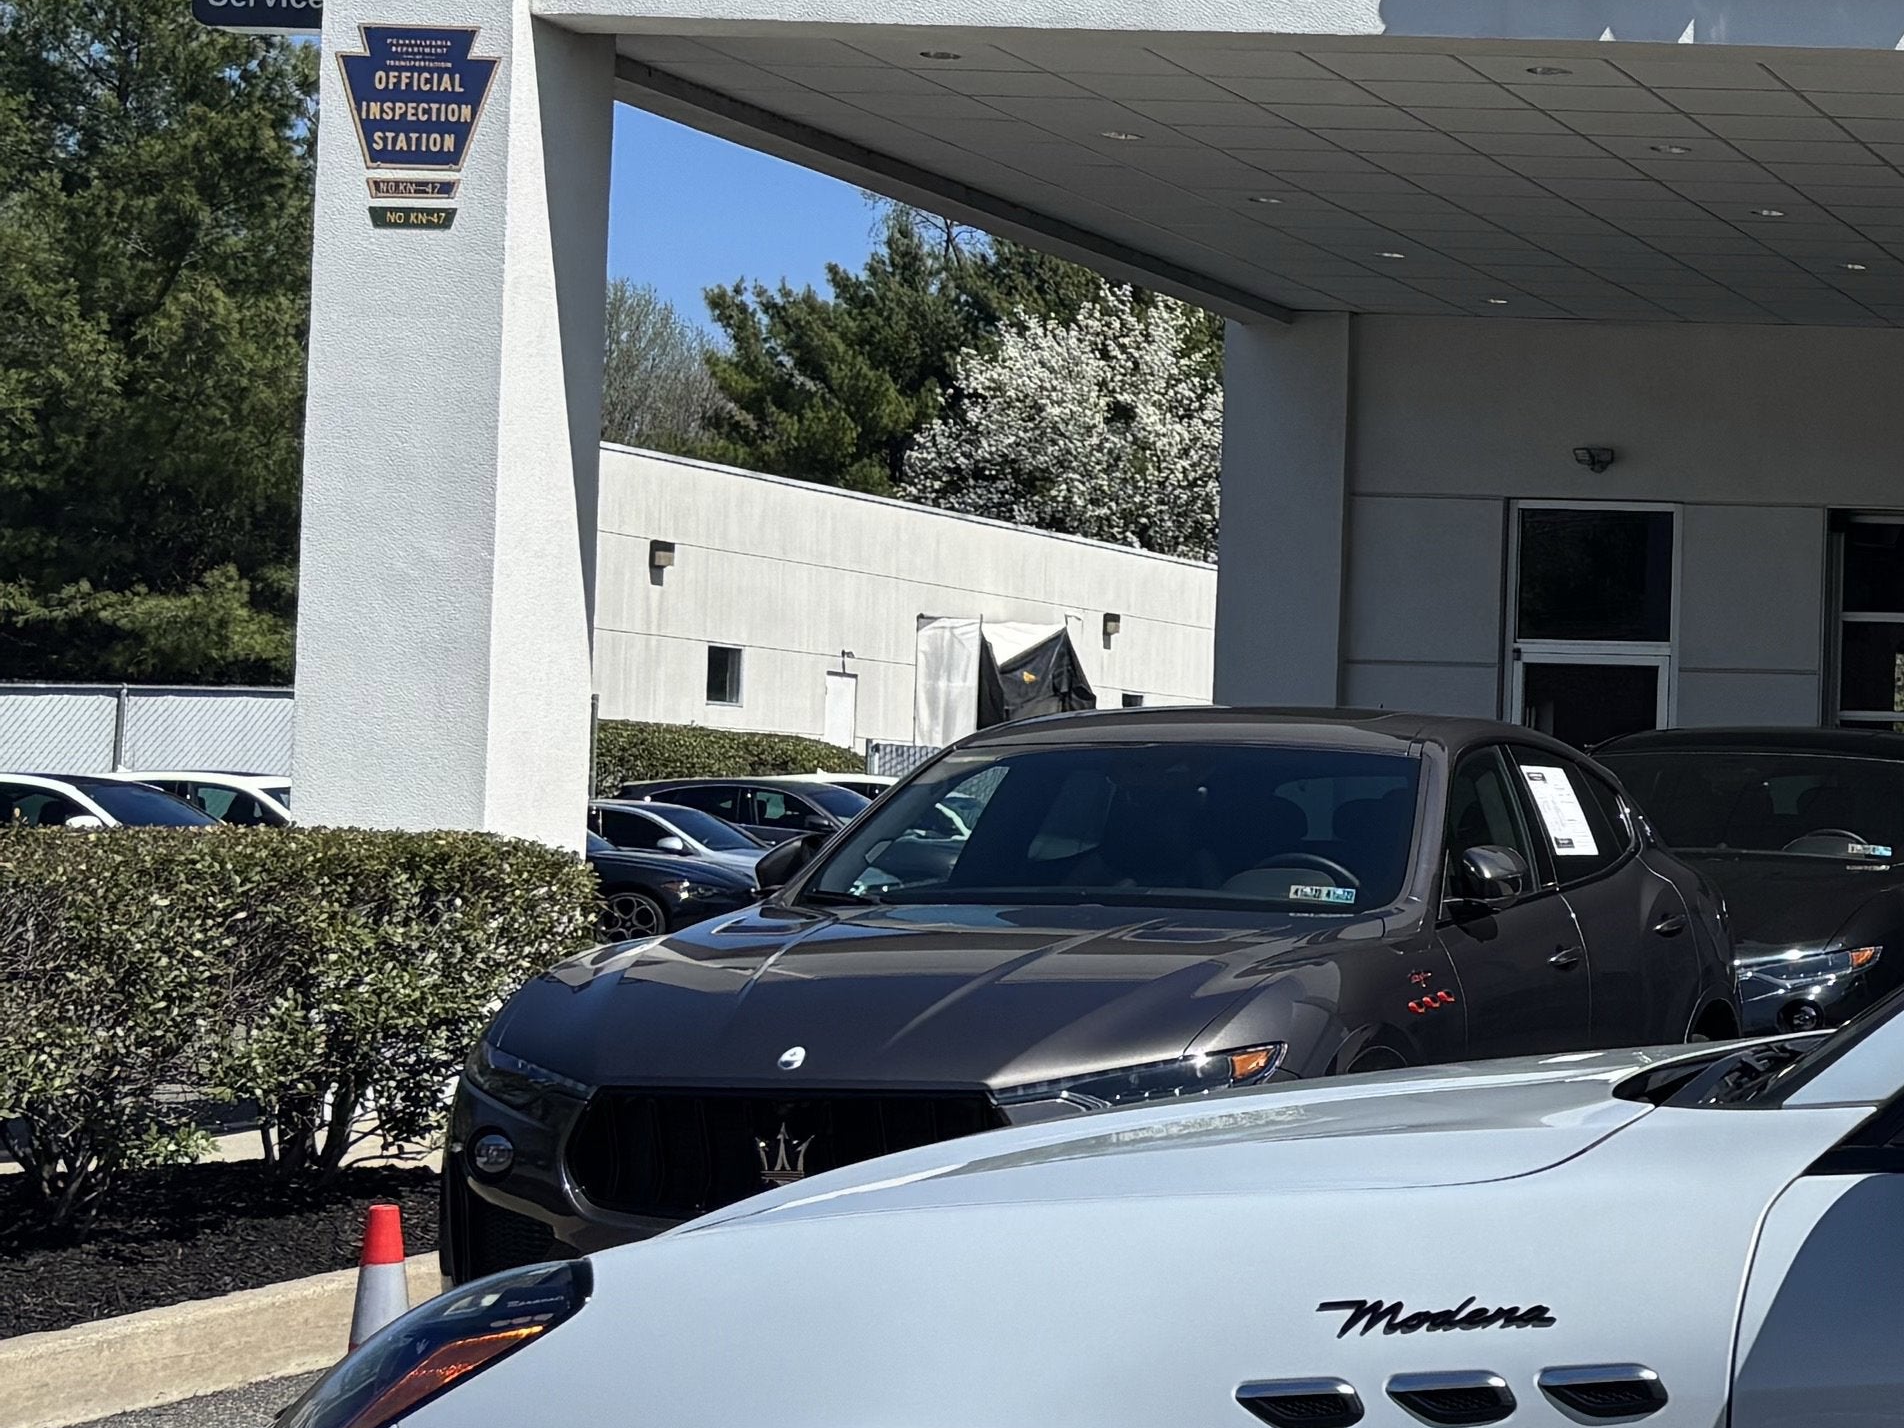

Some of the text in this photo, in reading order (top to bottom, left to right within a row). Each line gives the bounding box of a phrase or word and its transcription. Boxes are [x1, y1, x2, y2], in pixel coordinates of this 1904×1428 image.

[374, 70, 465, 93] OFFICIAL
[361, 101, 473, 123] INSPECTION
[372, 131, 455, 152] STATION
[386, 211, 446, 224] NO KN-47
[1315, 1296, 1557, 1339] Modena
